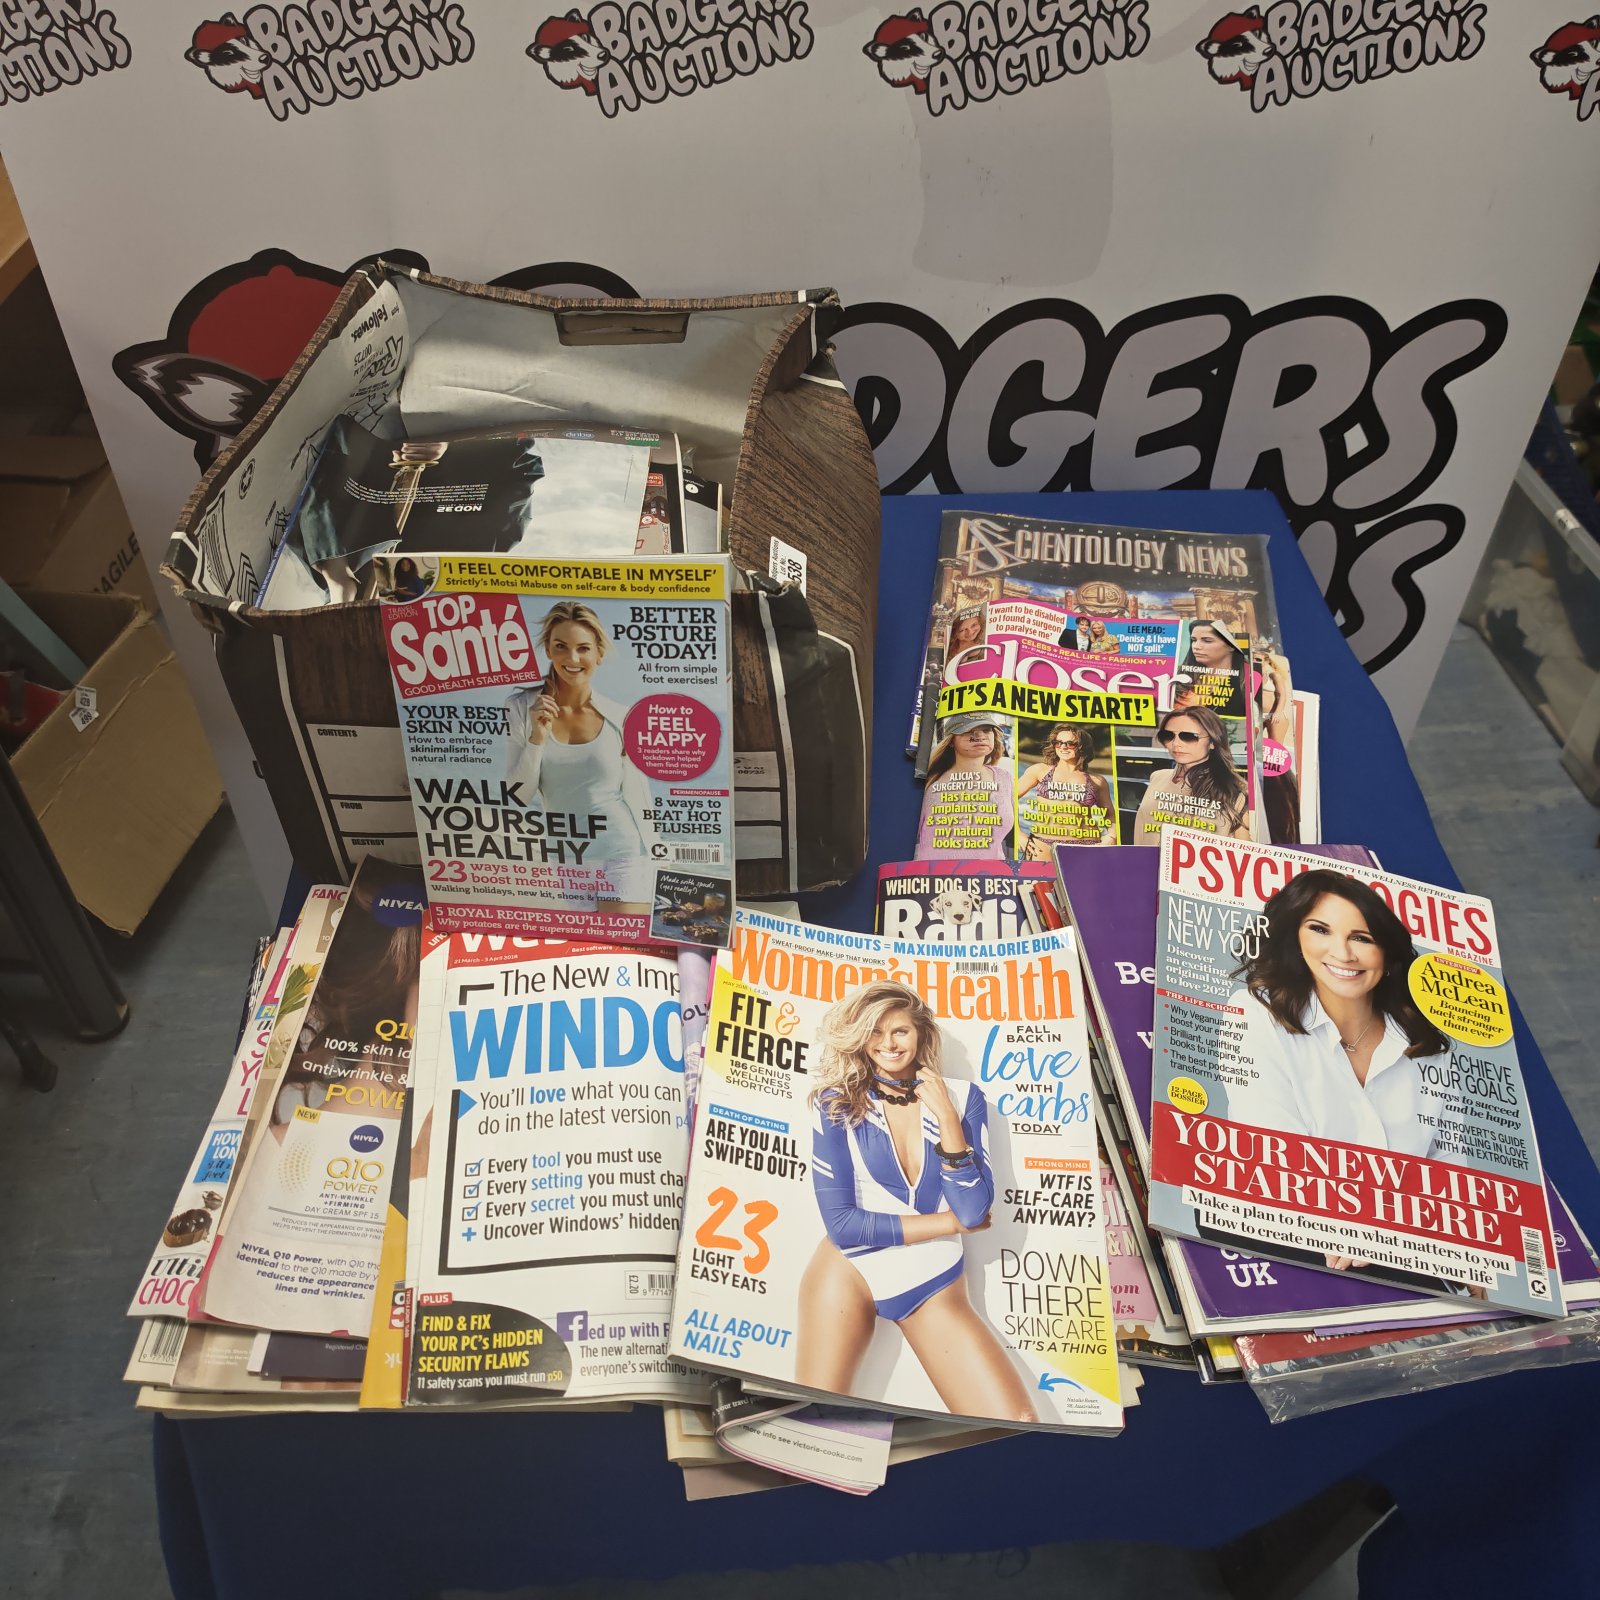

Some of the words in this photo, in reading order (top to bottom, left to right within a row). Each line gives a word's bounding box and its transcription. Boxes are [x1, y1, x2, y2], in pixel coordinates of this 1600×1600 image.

[262, 3, 476, 122] AUCTIONS
[597, 0, 813, 119] AUCTIONS
[926, 0, 1150, 117] AUCTIONS
[1250, 3, 1488, 114] AUCTIONS
[458, 563, 497, 576] FEEL
[501, 565, 620, 581] COMFORTABLE
[627, 568, 644, 581] IN
[650, 568, 717, 582] MYSELF'
[787, 558, 802, 584] 538
[1177, 544, 1248, 577] NEWS
[446, 577, 488, 588] Strictly's
[491, 579, 517, 588] Motsi
[521, 580, 558, 589] Mabuse
[561, 582, 572, 590] on
[576, 582, 617, 592] self-care
[620, 584, 627, 592] &
[630, 584, 655, 595] body
[659, 584, 711, 593] confidence
[423, 595, 476, 630] TOP
[630, 607, 717, 624] BETTER
[613, 625, 717, 642] POSTURE
[1128, 625, 1141, 634] LEE
[1142, 626, 1165, 636] MEAD:
[1147, 635, 1153, 643] &
[1154, 635, 1157, 644] I
[1159, 635, 1176, 644] have
[390, 606, 529, 685] Santé
[632, 643, 717, 660] TODAY!
[1128, 643, 1143, 652] NOT
[1181, 665, 1213, 675] PREGNANT
[1214, 667, 1239, 677] JORDAN
[404, 683, 436, 697] GOOD
[439, 677, 475, 691] HEALTH
[477, 674, 510, 686] STARTS
[513, 671, 537, 681] HERE
[991, 682, 1007, 708] A
[1010, 687, 1061, 717] NEW
[318, 729, 358, 738] CONTENTS
[649, 716, 696, 731] FEEL
[637, 731, 706, 747] HAPPY
[415, 779, 527, 807] WALK
[1048, 782, 1085, 791] NATALIE'S
[1049, 791, 1069, 799] BABY
[1070, 791, 1085, 800] JOY
[340, 802, 363, 810] FROM
[643, 810, 684, 822] BEAT
[688, 811, 721, 822] HOT
[419, 807, 607, 838] YOURSELF
[653, 822, 721, 834] FLUSHES
[425, 833, 590, 865] HEALTHY
[886, 879, 931, 896] WHICH
[935, 878, 964, 894] DOG
[967, 879, 980, 894] IS
[984, 879, 1018, 895] BEST
[379, 899, 424, 911] NIVEA
[1168, 896, 1212, 924] NEW
[1217, 906, 1269, 938] YEAR
[805, 929, 882, 950] WORKOUTS
[893, 941, 967, 958] MAXIMUM
[970, 941, 1028, 956] CALORIE
[1032, 931, 1071, 950] BURN
[1168, 920, 1212, 948] NEW
[1217, 930, 1260, 959] YOU
[1447, 947, 1494, 965] MAGAZINE
[500, 970, 546, 996] The
[553, 964, 610, 990] New
[616, 966, 631, 986] &
[914, 957, 1077, 1022] Health
[1422, 961, 1496, 996] Andrea
[1421, 977, 1504, 1015] McLean
[730, 992, 771, 1029] FIT
[776, 1002, 800, 1035] &
[324, 1038, 358, 1053] 100%
[363, 1044, 394, 1057] skin
[716, 1022, 809, 1075] FIERCE
[981, 1024, 1082, 1083] love
[302, 1061, 394, 1083] anti-wrinkle
[1449, 1052, 1513, 1087] ACHIEVE
[480, 1088, 524, 1110] You'll
[530, 1086, 566, 1104] love
[571, 1082, 612, 1100] what
[619, 1083, 649, 1105] you
[654, 1086, 681, 1102] can
[1016, 1083, 1052, 1093] WITH
[1170, 1086, 1203, 1099] 12-PAGE
[1418, 1063, 1463, 1089] YOUR
[1465, 1077, 1518, 1106] GOALS
[997, 1082, 1089, 1125] carbs
[1170, 1091, 1205, 1106] DOSSIER
[297, 1109, 317, 1120] NEW
[353, 1134, 379, 1144] NIVEA
[705, 1119, 735, 1144] ARE
[740, 1129, 770, 1152] YOU
[773, 1135, 800, 1157] ALL
[1012, 1123, 1062, 1134] TODAY
[326, 1156, 385, 1183] Q10
[488, 1156, 527, 1174] Every
[532, 1152, 561, 1168] tool
[566, 1151, 592, 1168] you
[597, 1148, 633, 1164] must
[638, 1150, 662, 1163] use
[704, 1142, 764, 1170] SWIPED
[767, 1156, 807, 1181] OUT?
[1169, 1110, 1289, 1169] YOUR
[1300, 1143, 1416, 1189] NEW
[1413, 1164, 1522, 1217] LIFE
[324, 1180, 378, 1195] POWER
[1040, 1174, 1074, 1191] WTF
[1077, 1176, 1093, 1190] IS
[1005, 1189, 1094, 1210] SELF-CARE
[1194, 1153, 1362, 1215] STARTS
[1372, 1187, 1501, 1245] HERE
[1013, 1207, 1096, 1228] ANYWAY?
[695, 1187, 778, 1274] 23
[1188, 1189, 1228, 1210] Make
[1232, 1202, 1240, 1211] a
[1243, 1205, 1275, 1226] plan
[1279, 1212, 1293, 1224] to
[1297, 1216, 1337, 1236] focus
[1340, 1227, 1359, 1238] on
[1362, 1230, 1400, 1247] what
[1403, 1239, 1461, 1262] matters
[1465, 1250, 1480, 1263] to
[1483, 1255, 1510, 1272] you
[693, 1249, 735, 1270] LIGHT
[1001, 1248, 1102, 1285] DOWN
[690, 1265, 730, 1285] EASY
[731, 1274, 767, 1295] EATS
[1226, 1265, 1278, 1289] UK
[423, 1294, 449, 1304] PLUS
[1002, 1281, 1105, 1318] THERE
[422, 1316, 453, 1331] FIND
[457, 1316, 467, 1330] &
[470, 1314, 491, 1330] FIX
[1005, 1315, 1107, 1341] SKINCARE
[420, 1335, 457, 1352] YOUR
[461, 1332, 489, 1350] PC's
[493, 1329, 543, 1347] HIDDEN
[418, 1354, 482, 1372] SECURITY
[485, 1352, 529, 1369] FLAWS
[743, 1424, 761, 1435] more
[762, 1430, 777, 1440] info
[778, 1437, 791, 1445] see
